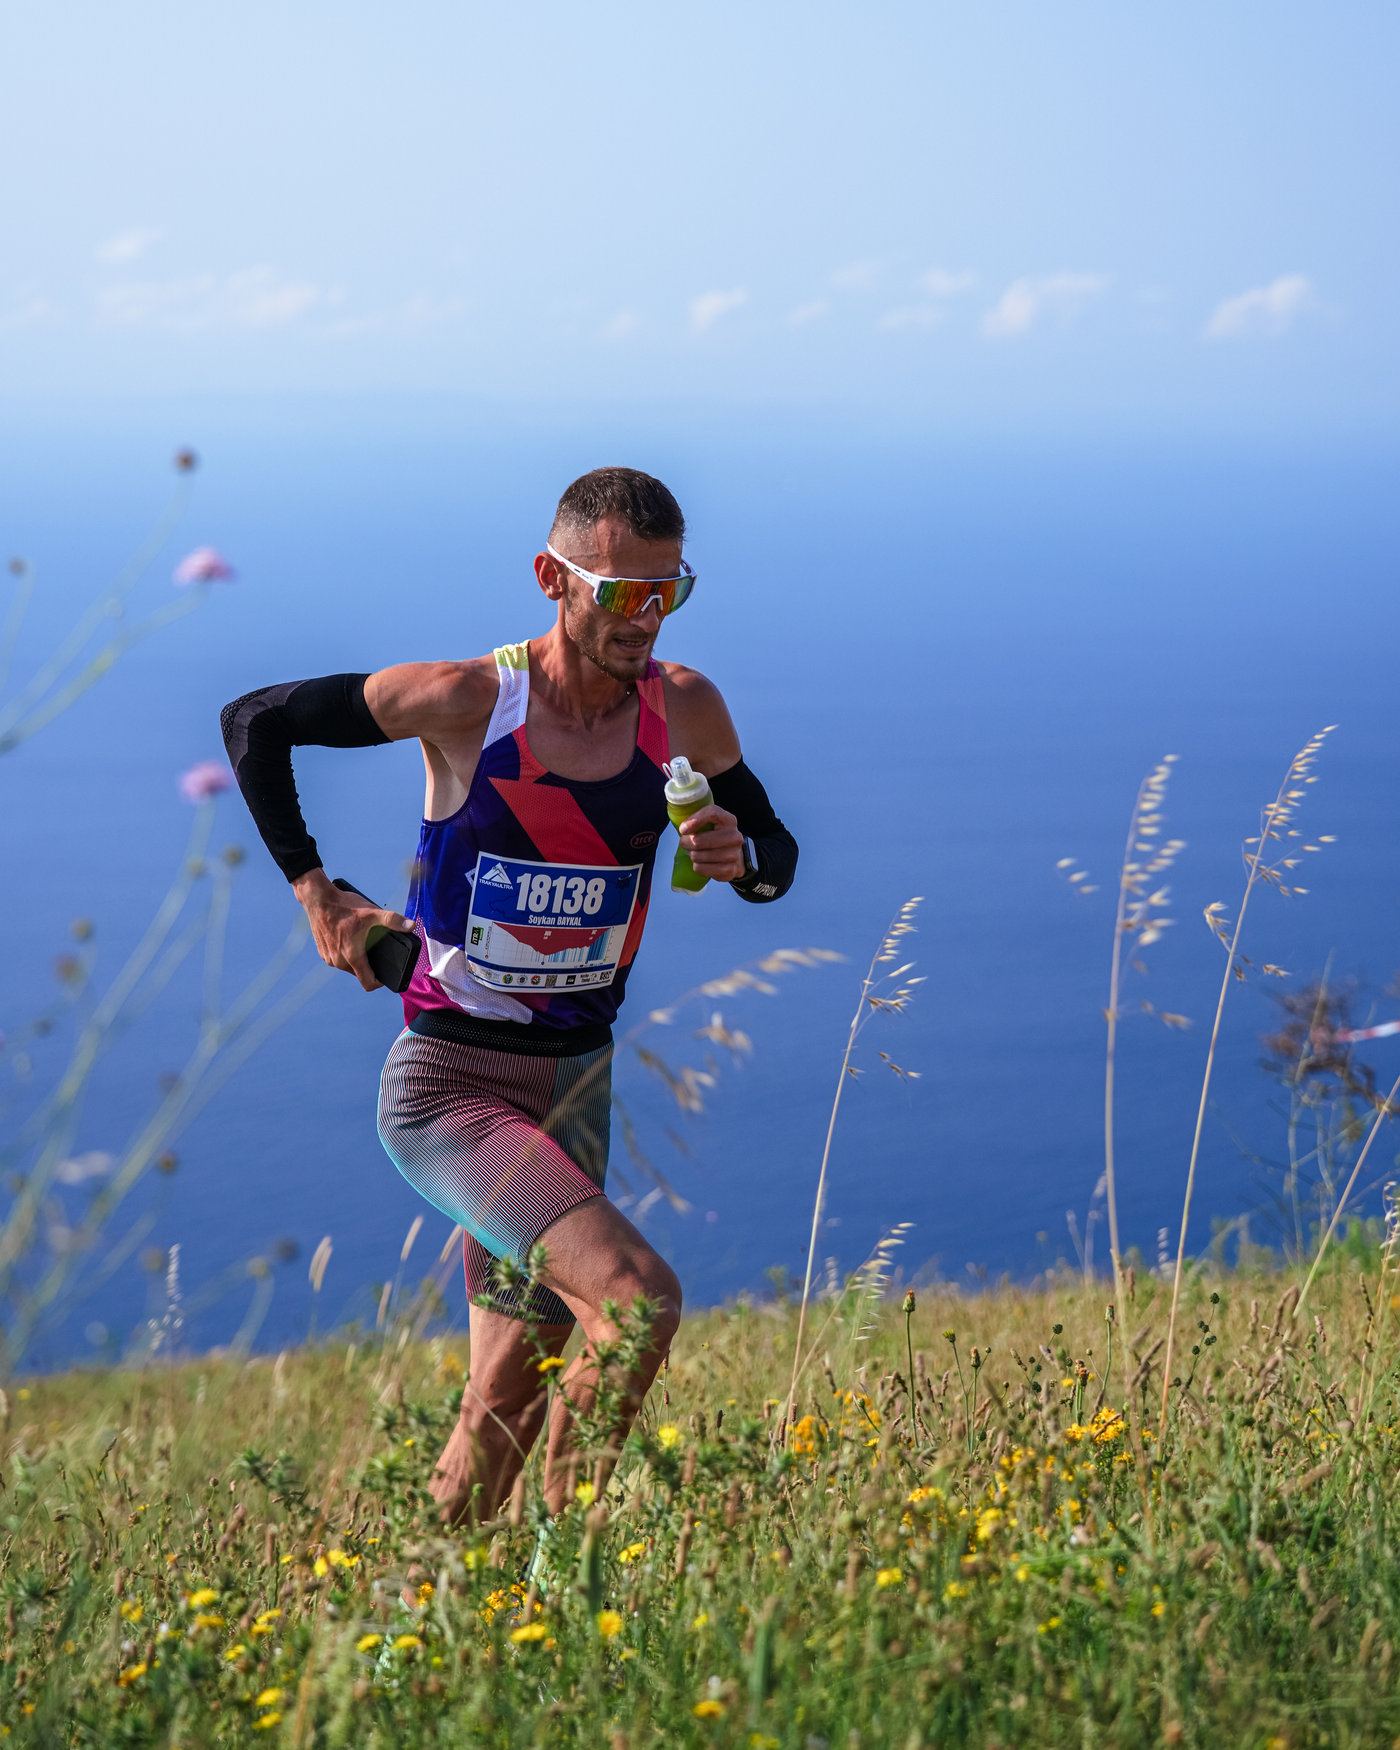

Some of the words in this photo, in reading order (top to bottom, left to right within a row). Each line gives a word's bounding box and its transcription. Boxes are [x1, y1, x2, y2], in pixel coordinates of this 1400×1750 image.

[479, 879, 514, 890] TRAKYAULTRA
[516, 873, 606, 915] 18138
[528, 915, 556, 926] Soykan
[557, 917, 582, 926] BAYKAL
